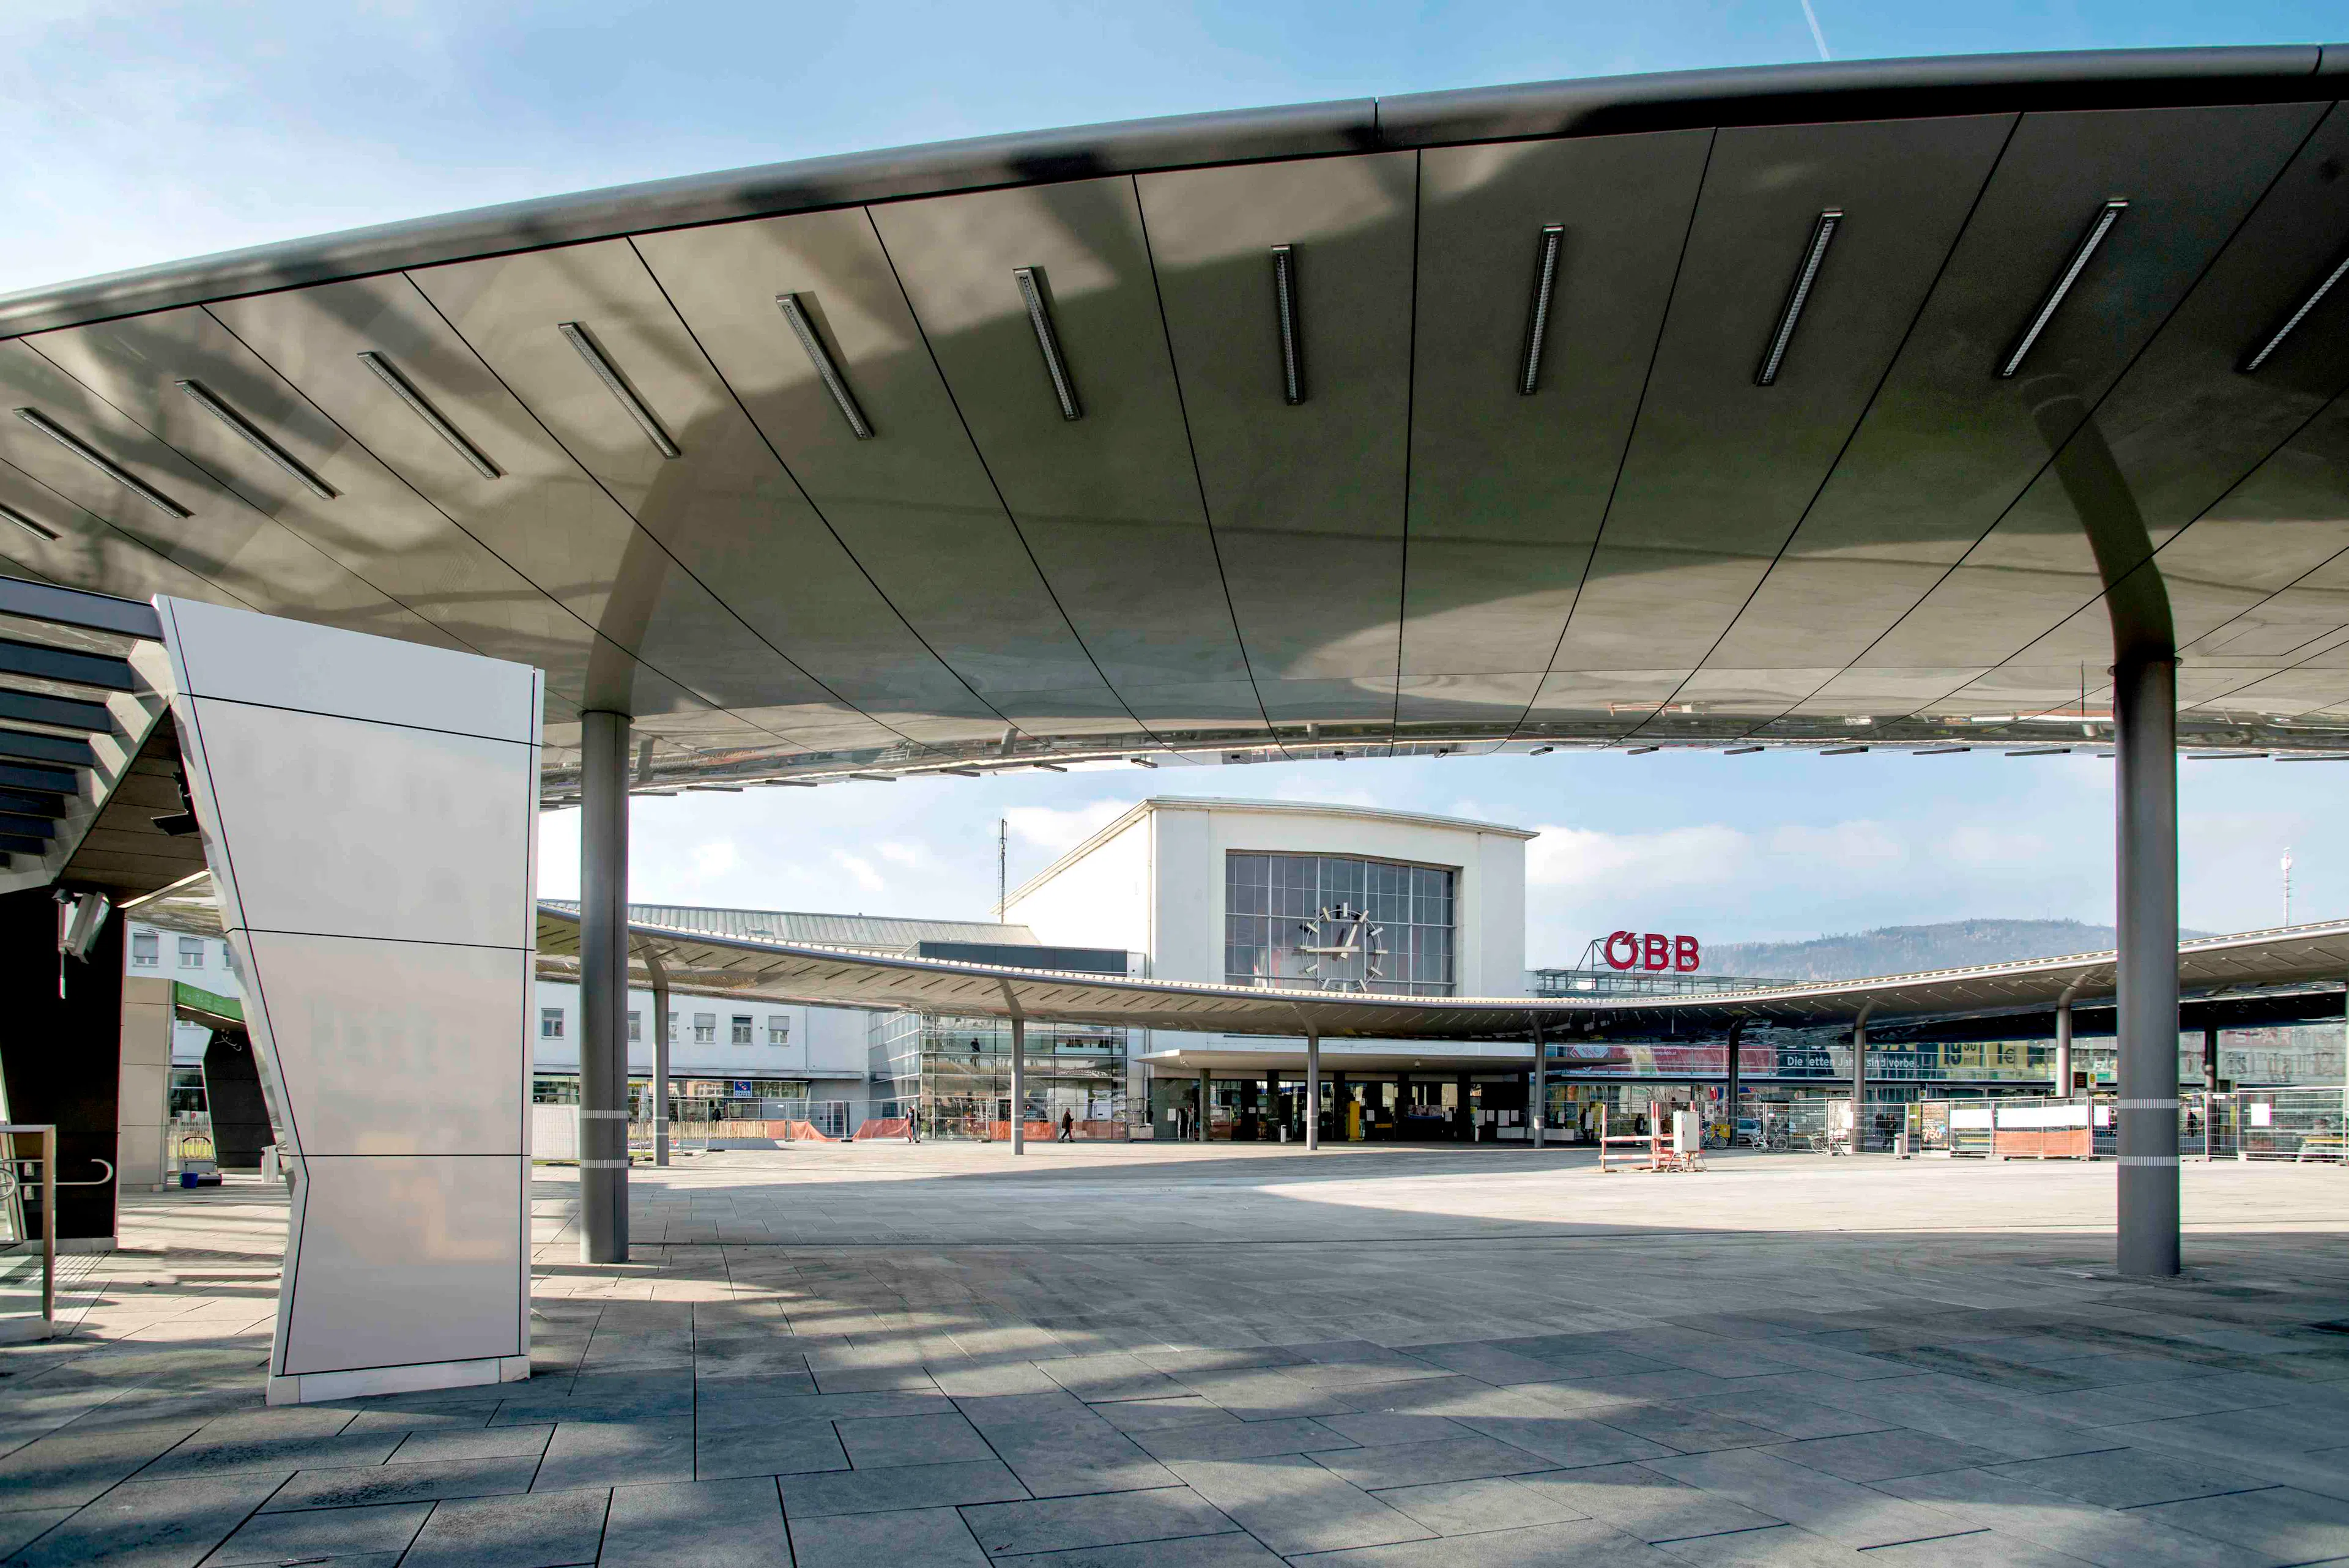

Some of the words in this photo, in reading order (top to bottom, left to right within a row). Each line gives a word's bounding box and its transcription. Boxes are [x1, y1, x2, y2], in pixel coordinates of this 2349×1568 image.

[1605, 931, 1700, 972] ÖBB
[1787, 1057, 1803, 1066] Die
[1806, 1057, 1835, 1066] etten
[1866, 1058, 1886, 1068] sind
